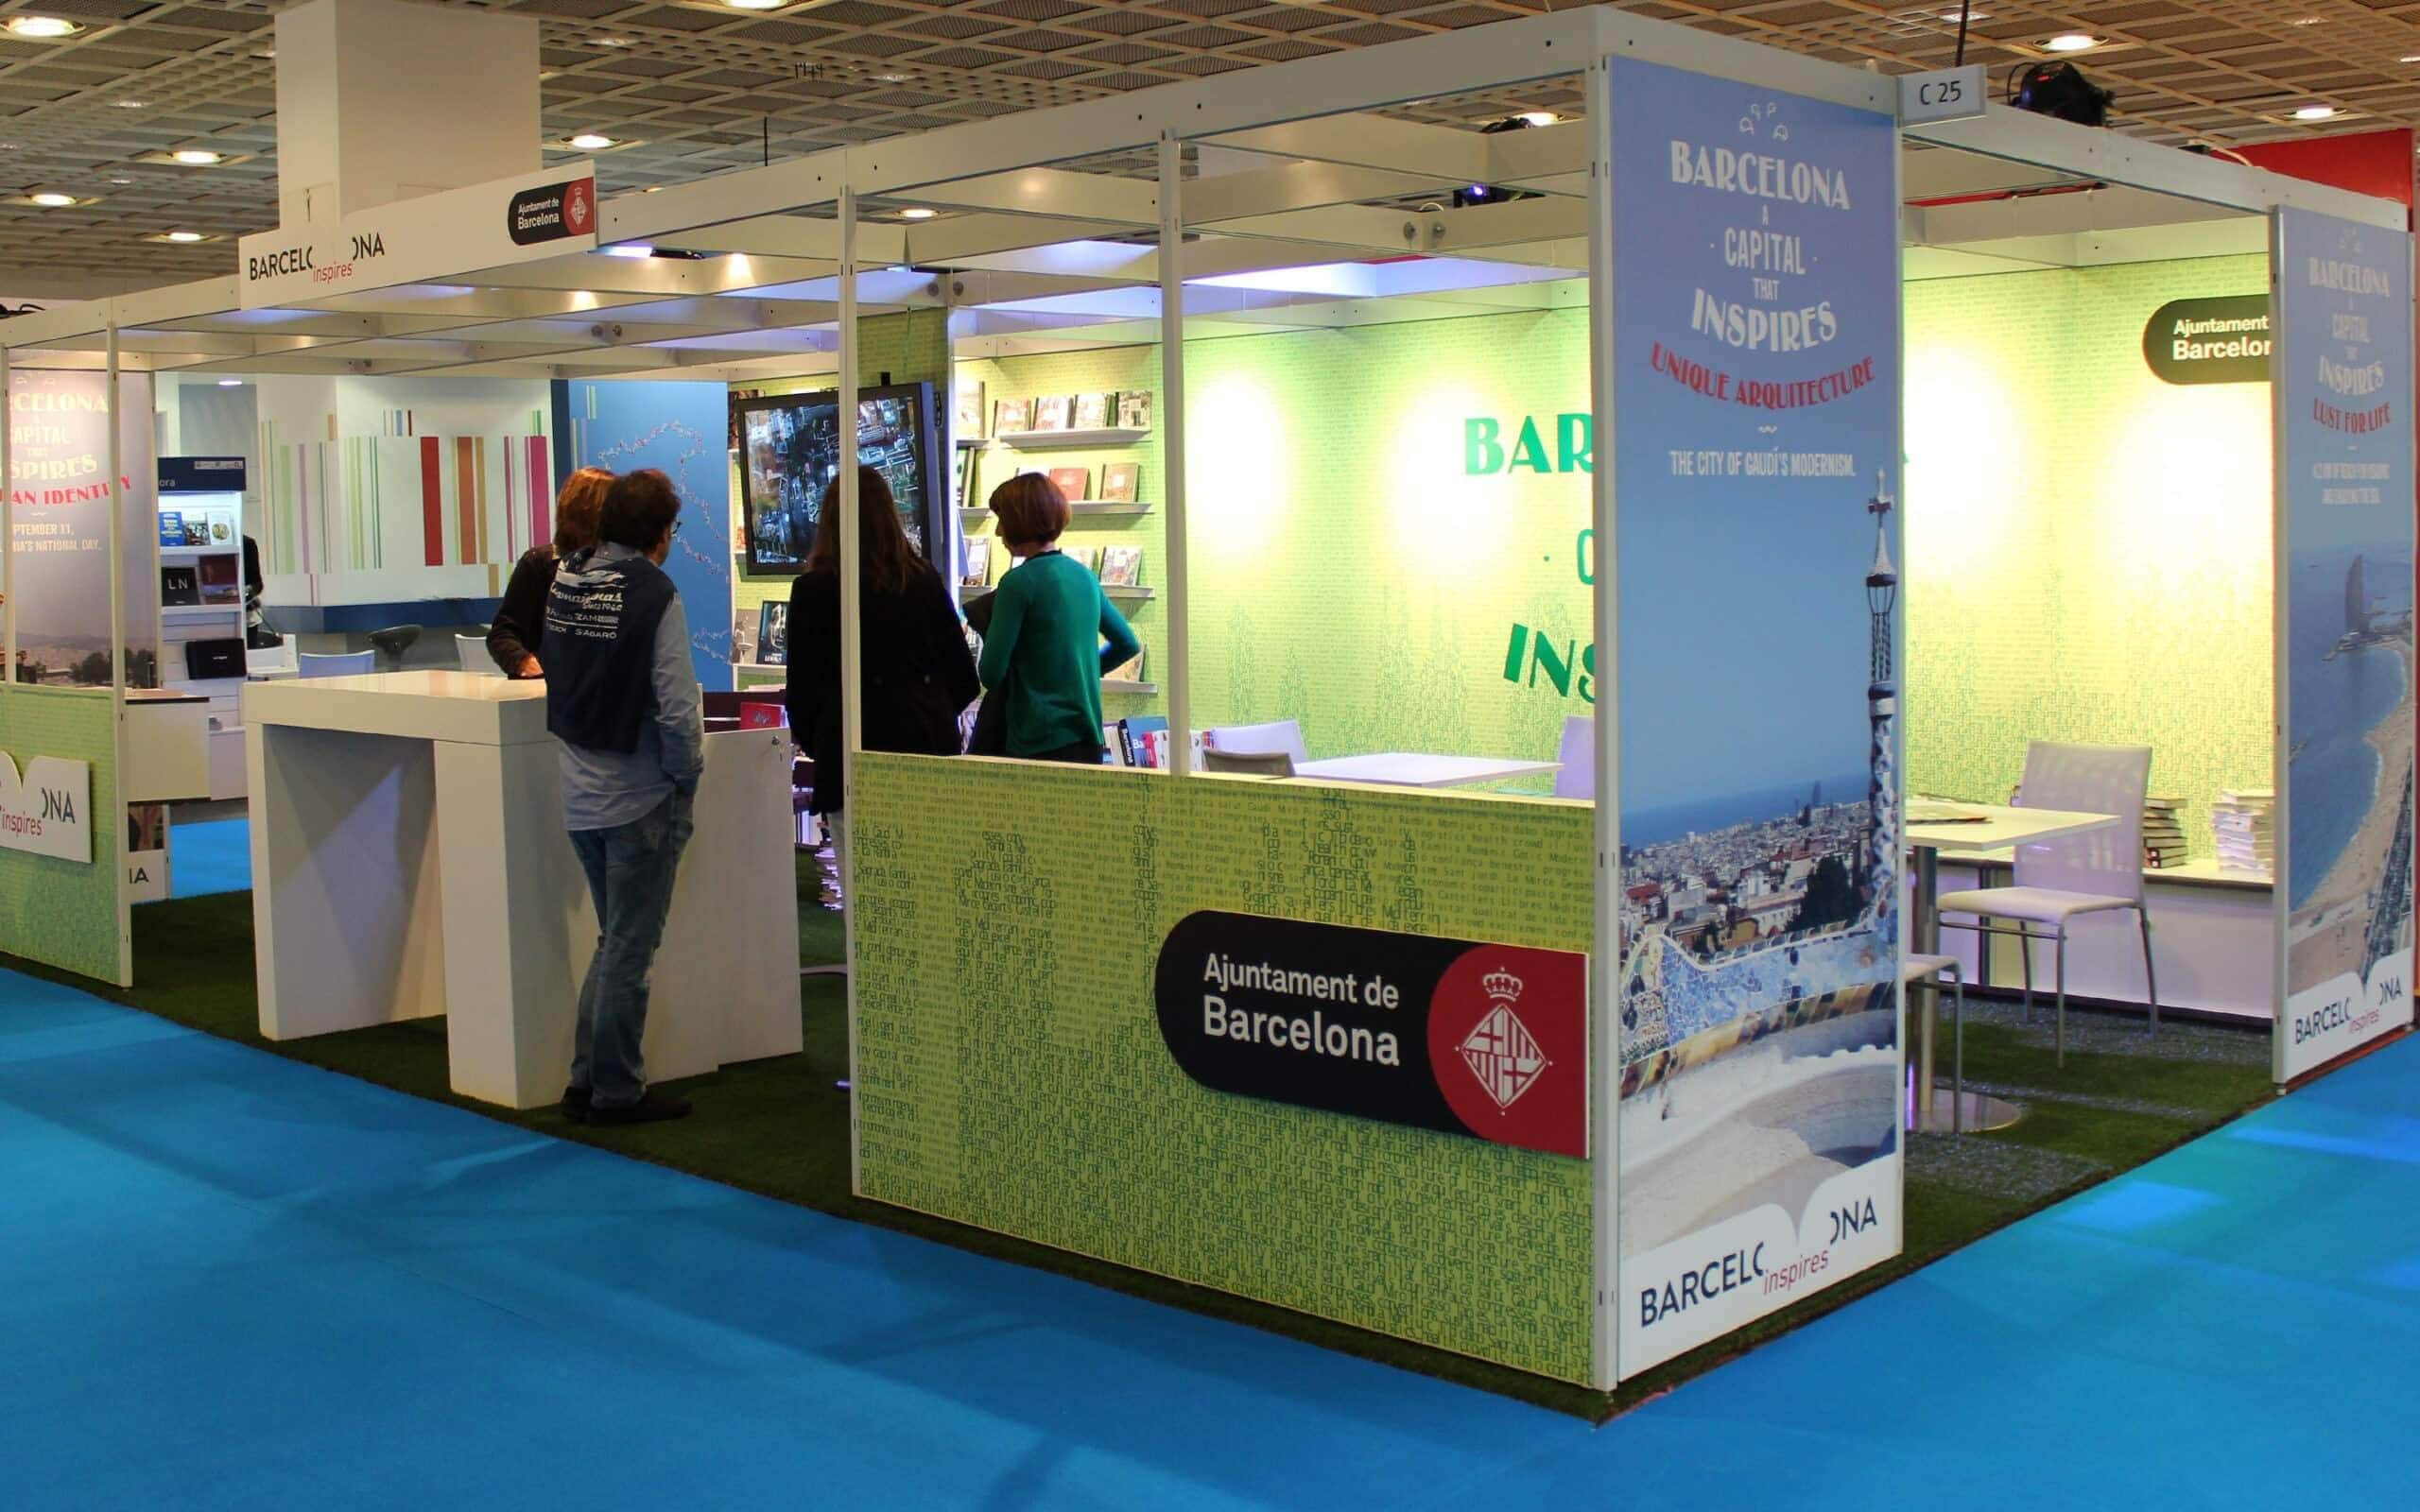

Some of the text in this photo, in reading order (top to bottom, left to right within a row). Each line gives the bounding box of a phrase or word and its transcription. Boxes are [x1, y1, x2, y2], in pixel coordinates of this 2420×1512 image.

[1920, 80, 1962, 105] C 25
[1670, 141, 1850, 210] BARCELONA
[518, 197, 560, 215] Ajuntament de
[1761, 204, 1769, 226] A
[518, 213, 560, 230] Barcelona
[1724, 227, 1806, 275] CAPITAL
[313, 261, 353, 284] inspires
[1753, 278, 1780, 301] THAT
[1691, 288, 1837, 352] INSPIRES
[2173, 315, 2270, 338] Ajuntament
[1651, 340, 1876, 410] UNIQUE ARQUITECTURE
[9, 392, 109, 413] CELONA
[2313, 397, 2345, 431] LUST
[1669, 450, 1694, 476] THE
[1697, 451, 1725, 475] CITY
[1727, 452, 1743, 475] OF
[43, 475, 132, 505] IDENTIY
[2, 810, 43, 837] inspires
[1202, 952, 1400, 1010] Ajuntament de
[1202, 994, 1400, 1067] Barcelona
[1764, 1249, 1829, 1296] inspires
